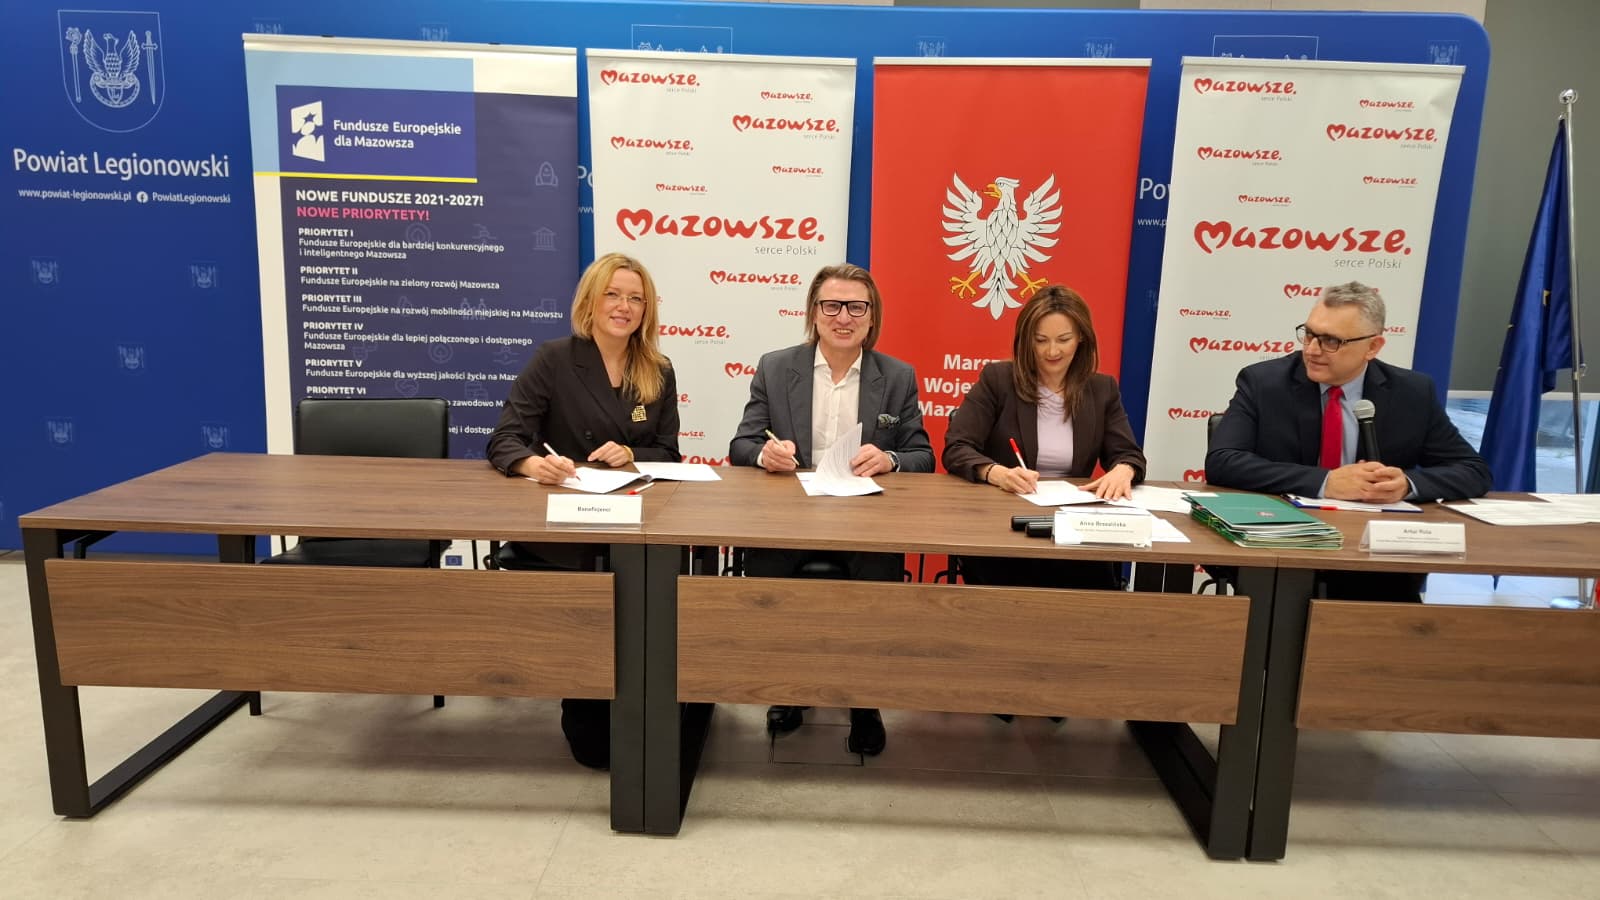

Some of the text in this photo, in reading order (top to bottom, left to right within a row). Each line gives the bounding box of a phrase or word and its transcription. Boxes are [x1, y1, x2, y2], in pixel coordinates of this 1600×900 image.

[600, 70, 700, 86] Mazowsze.
[1194, 78, 1296, 94] Mazowsze.
[333, 120, 462, 136] Fundusze Europejskie
[732, 114, 840, 132] Mazowsze.
[1326, 124, 1438, 142] Mazowsze.
[334, 135, 414, 148] dla Mazowsza
[610, 136, 694, 150] Mazowsze.
[1198, 146, 1282, 160] Mazowsze.
[13, 148, 229, 180] Powiat Legionowski
[18, 188, 230, 204] www.powiat-legionowski.pl PowiatLegionowski
[296, 190, 484, 206] NOWE FUNDUSZE 2021-2027!
[297, 207, 430, 220] NOWE PRIORYTETY!
[616, 208, 824, 242] Mazowsze.
[298, 228, 354, 237] PRIORYTET I
[1194, 221, 1412, 255] Mazowsze.
[299, 238, 504, 253] Fundusze Europejskie dla bardziej konkurencyjnego
[755, 244, 817, 256] serce Polski
[304, 248, 364, 259] inteligentnego
[366, 250, 407, 259] Mazowsza
[1335, 258, 1401, 268] serce Polski
[300, 266, 358, 275] PRIORYTET II
[710, 270, 802, 285] Mazowsze.
[301, 276, 340, 285] Fundusze
[342, 277, 388, 287] Europejskie
[401, 278, 429, 288] zielony
[431, 280, 458, 290] rozwój
[460, 280, 500, 289] Mazowsza
[302, 294, 362, 303] PRIORYTET III
[302, 304, 341, 313] Fundusze
[342, 305, 389, 315] Europejskie
[402, 306, 428, 316] rozwój
[430, 306, 473, 316] mobilności
[475, 308, 510, 318] miejskiej
[522, 310, 563, 318] Mazowszu
[303, 321, 364, 330] PRIORYTET IV
[659, 325, 730, 338] zowsze.
[304, 332, 342, 340] Fundusze
[344, 332, 390, 342] Europejskie
[392, 333, 404, 342] dla
[406, 334, 428, 344] lepiej
[430, 335, 479, 344] połączonego
[486, 336, 532, 346] dostępnego
[304, 342, 346, 350] Mazowsza
[1190, 337, 1294, 353] Mazowsze
[305, 359, 354, 368] PRIORYTET
[306, 368, 344, 377] Fundusze
[346, 370, 391, 379] Europejskie
[393, 370, 405, 378] dla
[407, 371, 437, 381] wyższej
[438, 372, 466, 381] jakości
[467, 372, 486, 381] życia
[306, 386, 354, 394] PRIORYTET
